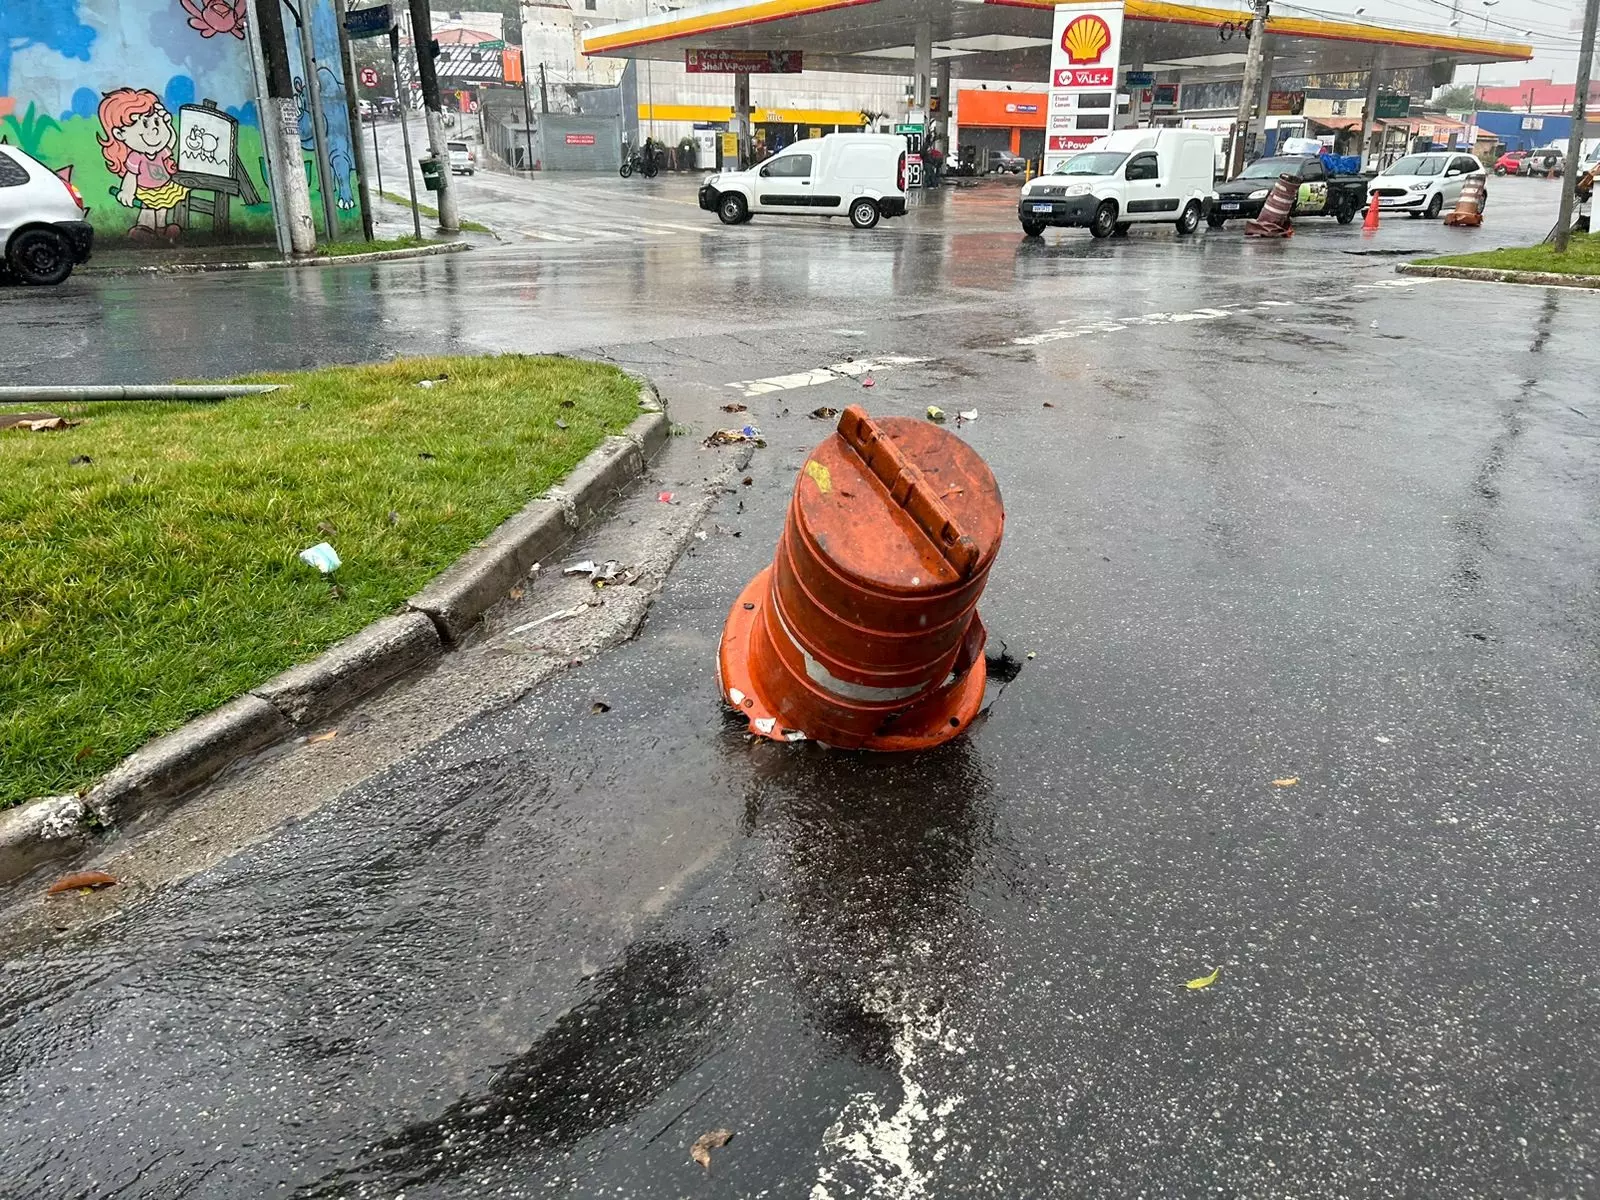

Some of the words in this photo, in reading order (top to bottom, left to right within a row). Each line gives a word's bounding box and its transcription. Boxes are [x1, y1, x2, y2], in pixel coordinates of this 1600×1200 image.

[701, 62, 723, 71] Shell
[724, 62, 762, 72] V-Power
[1076, 72, 1109, 84] VALE+
